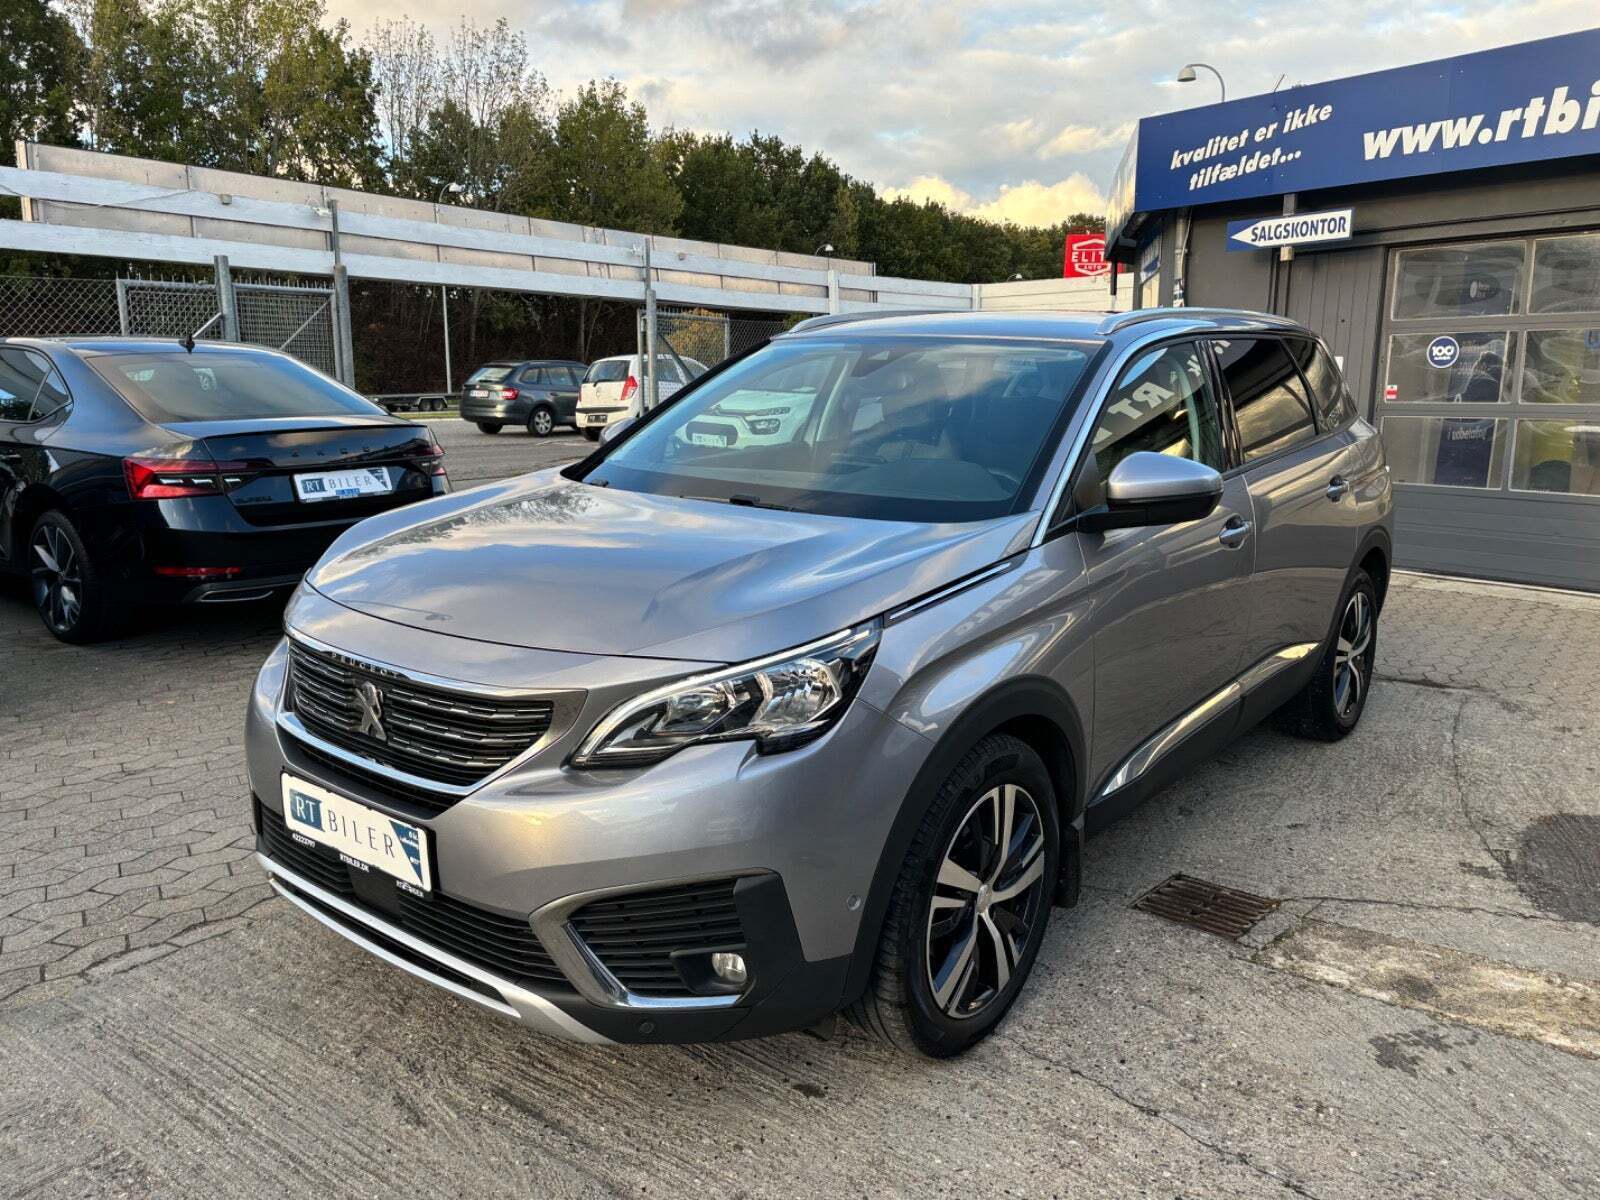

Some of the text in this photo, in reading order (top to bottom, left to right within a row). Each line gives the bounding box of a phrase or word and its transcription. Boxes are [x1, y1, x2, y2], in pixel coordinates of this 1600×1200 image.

[1170, 104, 1333, 170] kvalitet er ikke
[1189, 147, 1301, 191] tilfældet...
[1251, 216, 1346, 242] SALGSKONTOR
[305, 476, 372, 491] RT BILER
[296, 797, 395, 859] RT BILER
